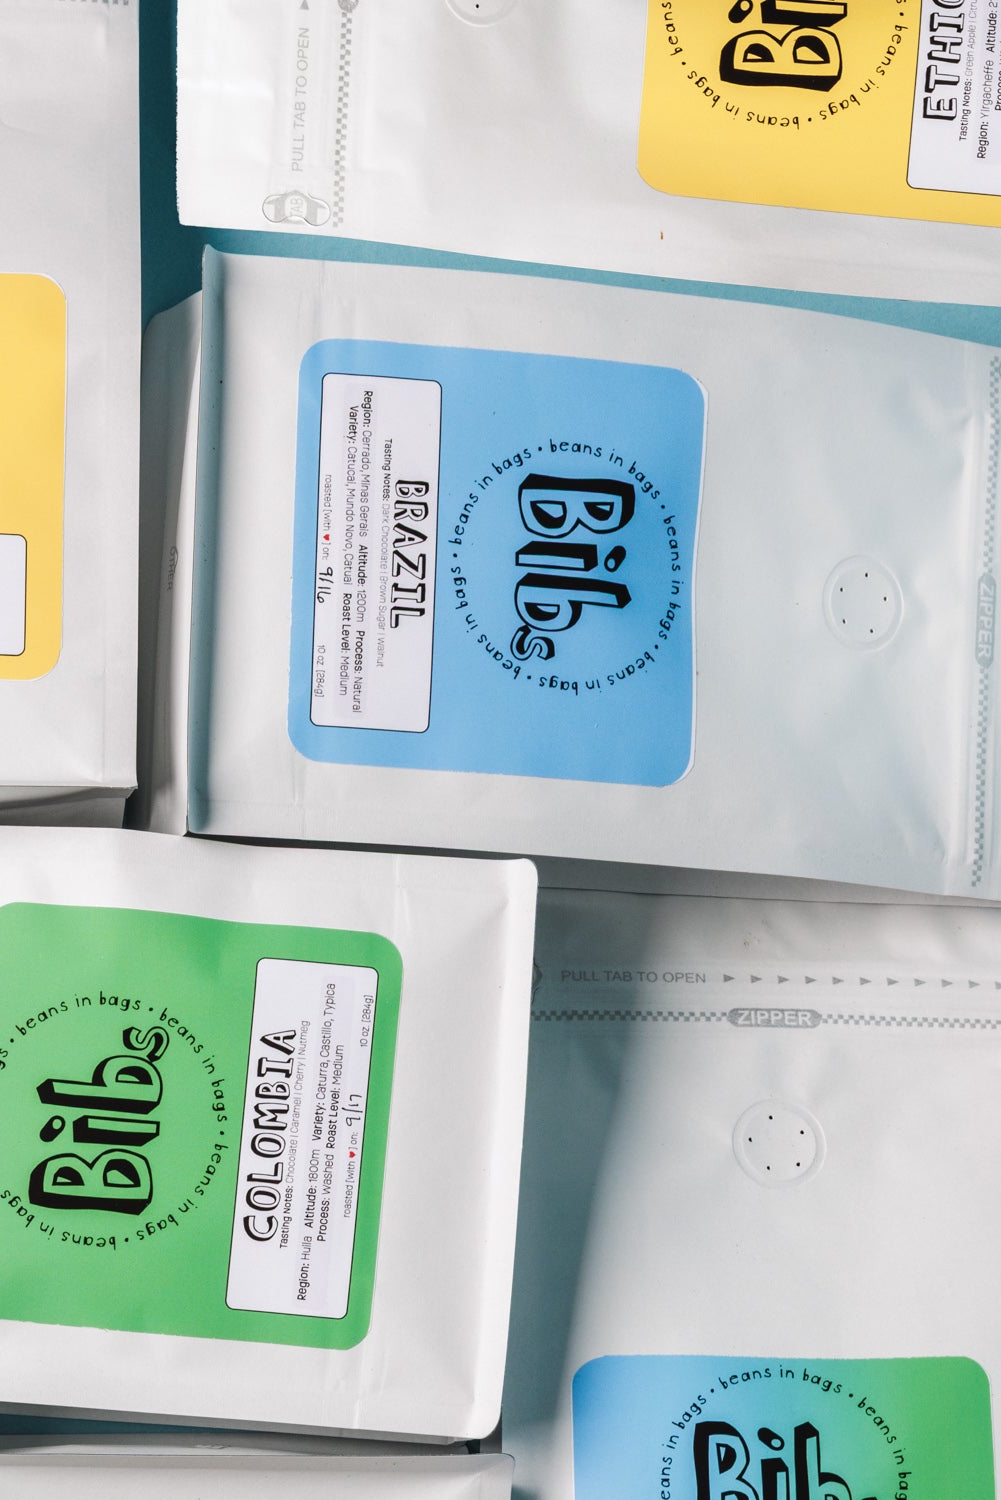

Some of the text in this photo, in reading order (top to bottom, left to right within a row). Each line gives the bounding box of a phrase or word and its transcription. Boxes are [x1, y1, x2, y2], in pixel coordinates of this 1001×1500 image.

[291, 27, 310, 172] PULL TAB TO OPEN
[976, 9, 997, 158] Region: Yirgacheffe Altitude:
[316, 567, 333, 603] 9/16
[349, 389, 374, 713] Region: Cerrado, Minas Gerais Altitude: 1200m Process: Natural
[389, 479, 429, 628] BRAZIL
[510, 473, 635, 661] Bibs
[978, 582, 995, 658] ZIPPER
[16, 991, 141, 1036] beans in bags
[561, 969, 706, 984] PULL TAB TO OPEN
[738, 1009, 813, 1026] ZIPPER
[29, 1026, 169, 1215] Bibs
[243, 1029, 296, 1241] COLOMBIA
[296, 983, 336, 1300] Region: Huila Altitude: 1800m Variety: Caturra, Castillo, Typica
[341, 1094, 363, 1126] 9/17
[719, 1365, 843, 1394] beans in bags
